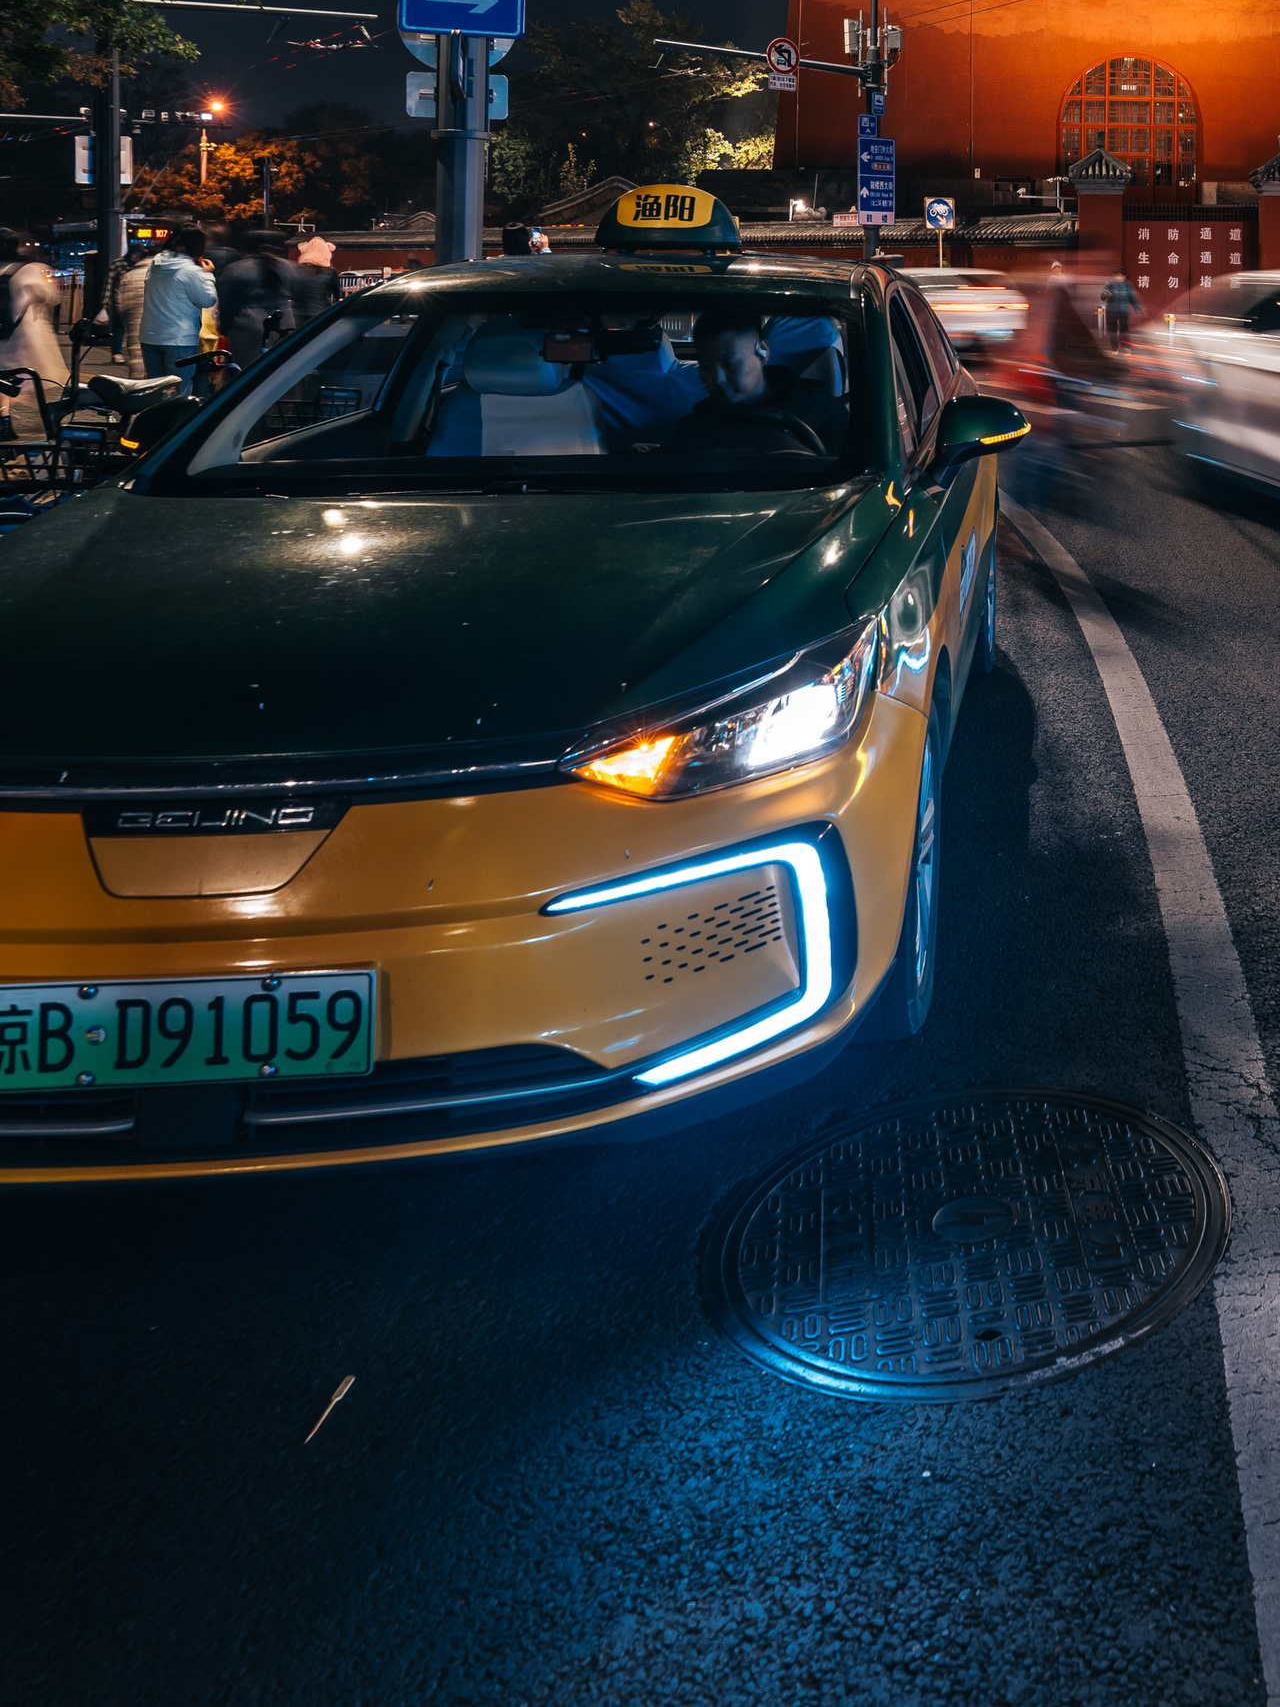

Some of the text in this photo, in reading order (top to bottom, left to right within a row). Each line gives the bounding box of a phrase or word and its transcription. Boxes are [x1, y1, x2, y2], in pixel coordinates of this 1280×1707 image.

[633, 194, 696, 222] 渔阳
[1138, 227, 1241, 241] 消防通道
[1138, 251, 1241, 265] 生命通道
[117, 806, 314, 828] BEIJING
